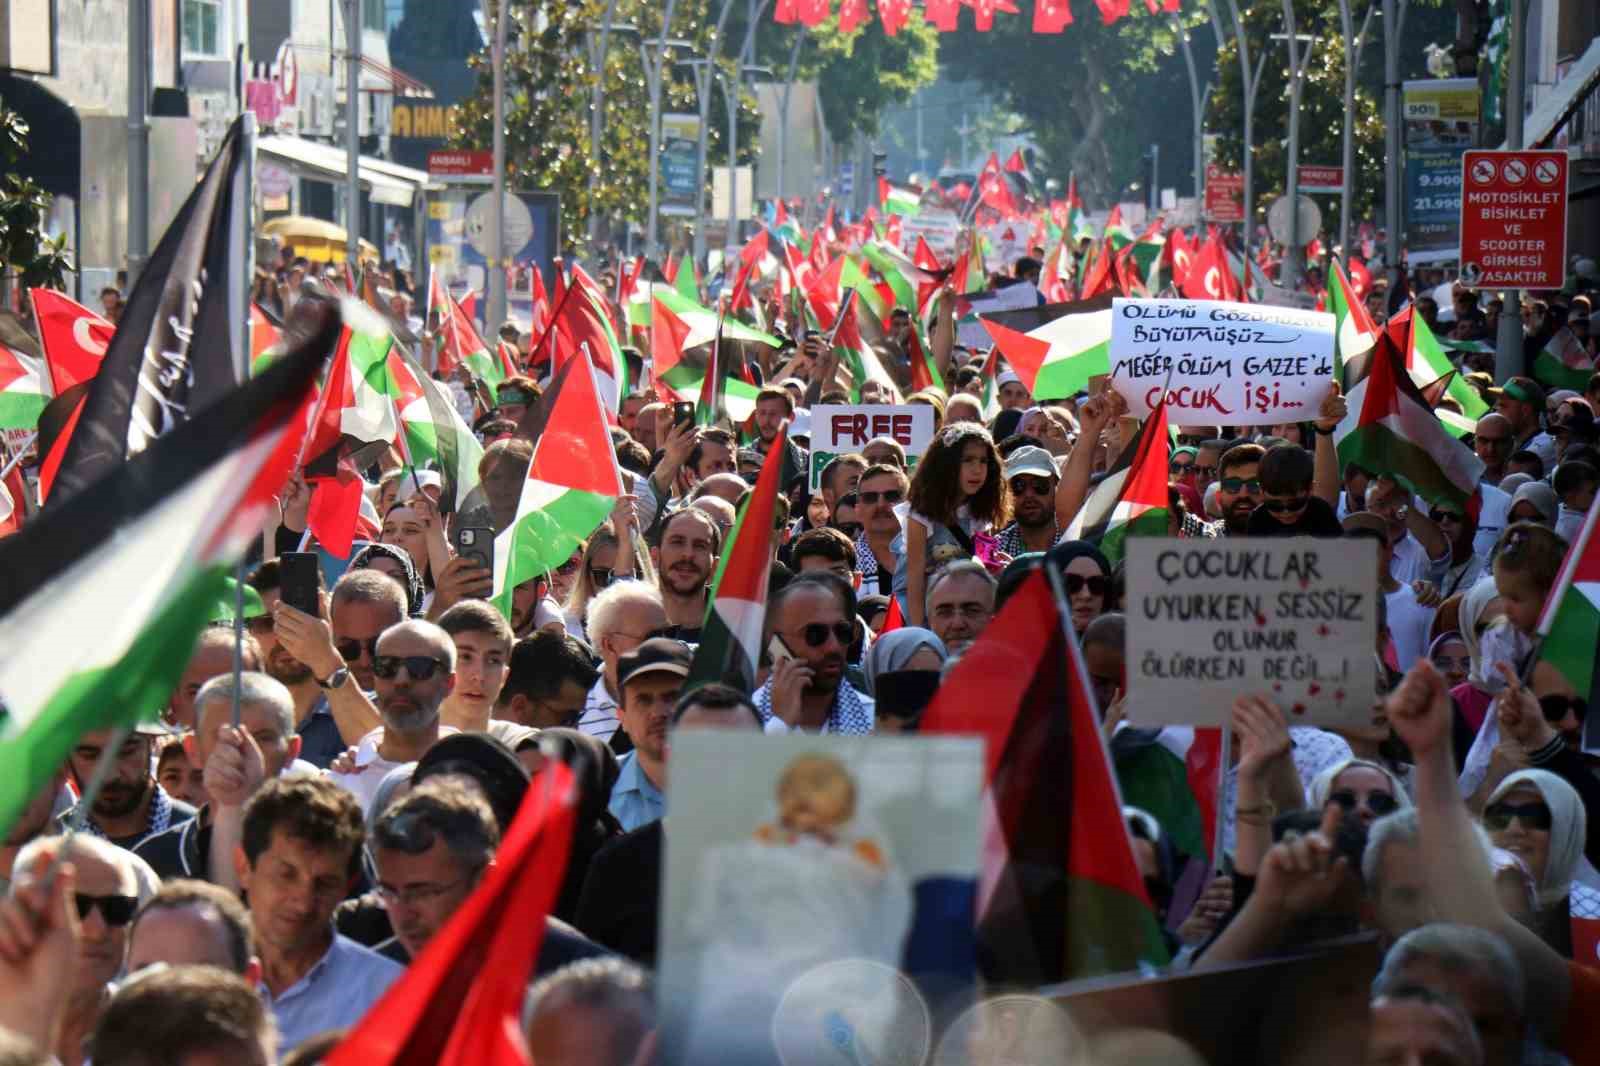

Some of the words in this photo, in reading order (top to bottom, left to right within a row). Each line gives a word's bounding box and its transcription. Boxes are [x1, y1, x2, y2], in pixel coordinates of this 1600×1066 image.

[1468, 190, 1560, 203] MOTOSİKLET
[1481, 206, 1547, 219] BİSİKLET
[1503, 224, 1522, 235] VE
[1480, 240, 1545, 251] SCOOTER
[1482, 254, 1542, 266] GİRMESİ
[1133, 325, 1301, 346] BÜYÜTMÜŞÜZ
[1112, 348, 1173, 378] MEĞER
[1178, 353, 1231, 378] ÖLÜM
[831, 413, 913, 446] FREE
[1156, 551, 1322, 583] ÇOCUKLAR
[1143, 594, 1261, 621] UYURKEN
[1276, 588, 1363, 621] SESSİZ
[1212, 629, 1297, 651] OLUNUR
[1141, 650, 1246, 680] ÖLÜRKEN
